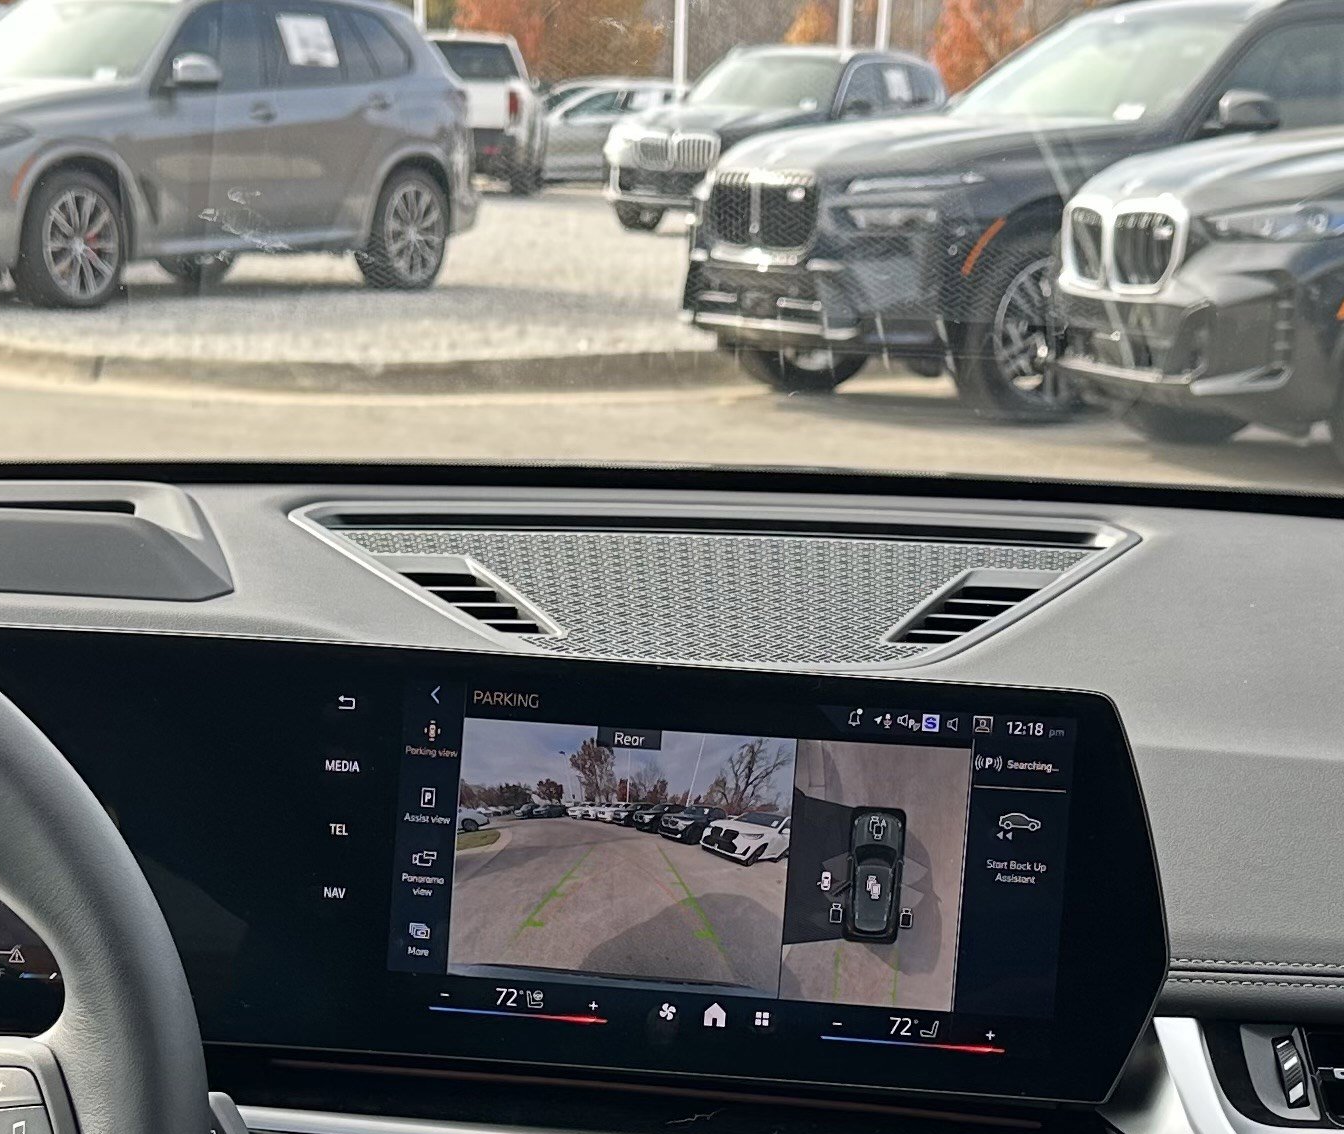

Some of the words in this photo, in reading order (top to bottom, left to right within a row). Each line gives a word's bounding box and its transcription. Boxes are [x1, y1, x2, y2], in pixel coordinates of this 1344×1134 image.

[473, 690, 539, 708] PARKING
[1007, 721, 1044, 736] 12:18
[1048, 728, 1065, 738] pm
[614, 732, 645, 746] Rear
[405, 745, 437, 758] Parking
[438, 749, 458, 758] view
[325, 759, 360, 773] MEDIA
[404, 813, 429, 824] Assist
[431, 816, 451, 826] view
[329, 823, 348, 837] TEL
[986, 859, 1007, 870] Start
[1009, 861, 1032, 872] Back
[1034, 862, 1047, 873] Up
[402, 872, 445, 885] Panorama
[995, 873, 1036, 885] Assistant
[323, 886, 346, 899] NAV
[412, 886, 433, 897] view
[407, 946, 430, 957] More
